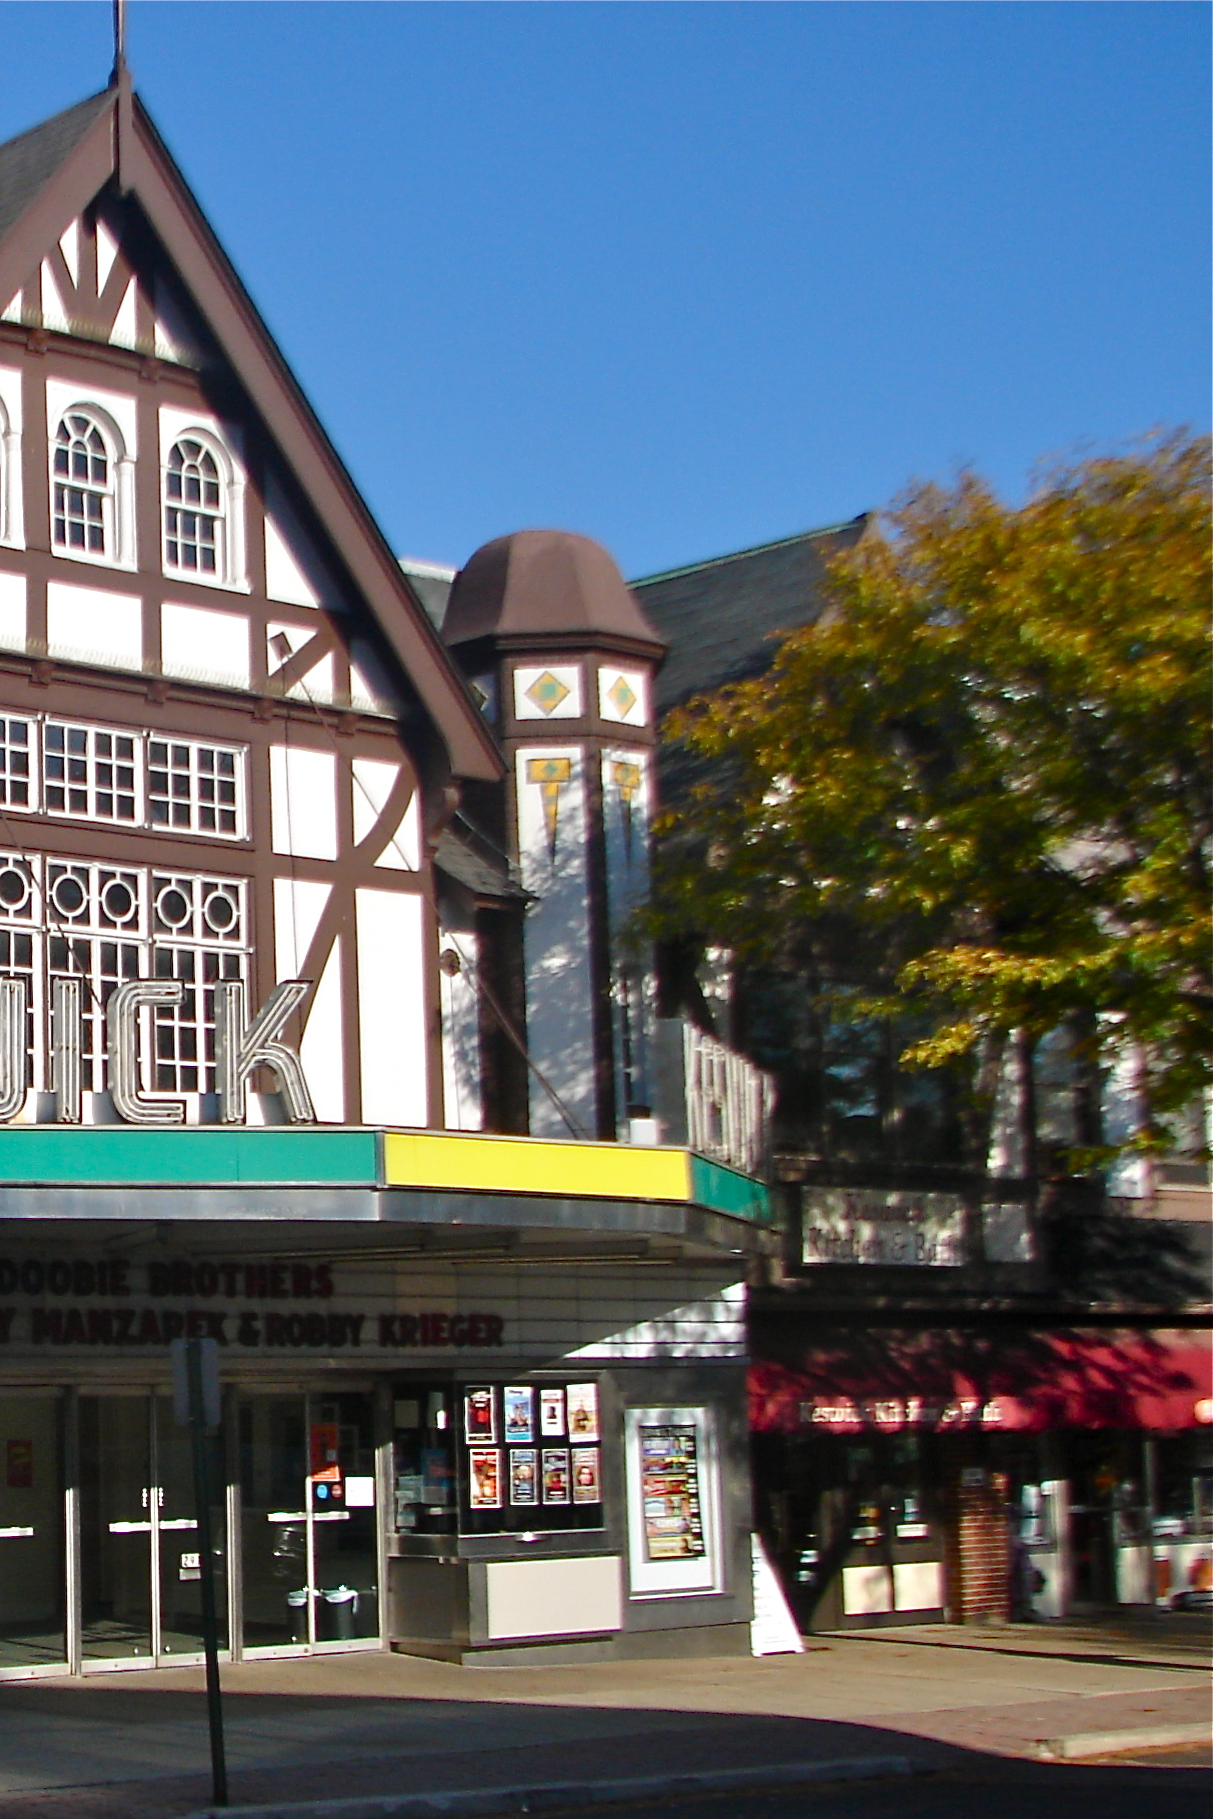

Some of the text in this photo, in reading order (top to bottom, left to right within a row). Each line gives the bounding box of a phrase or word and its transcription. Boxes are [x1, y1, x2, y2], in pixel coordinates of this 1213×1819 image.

[149, 1261, 335, 1298] BROTHERS
[31, 1307, 228, 1346] MANZAREK
[264, 1312, 366, 1347] ROBBY
[378, 1313, 505, 1348] KRIEGER
